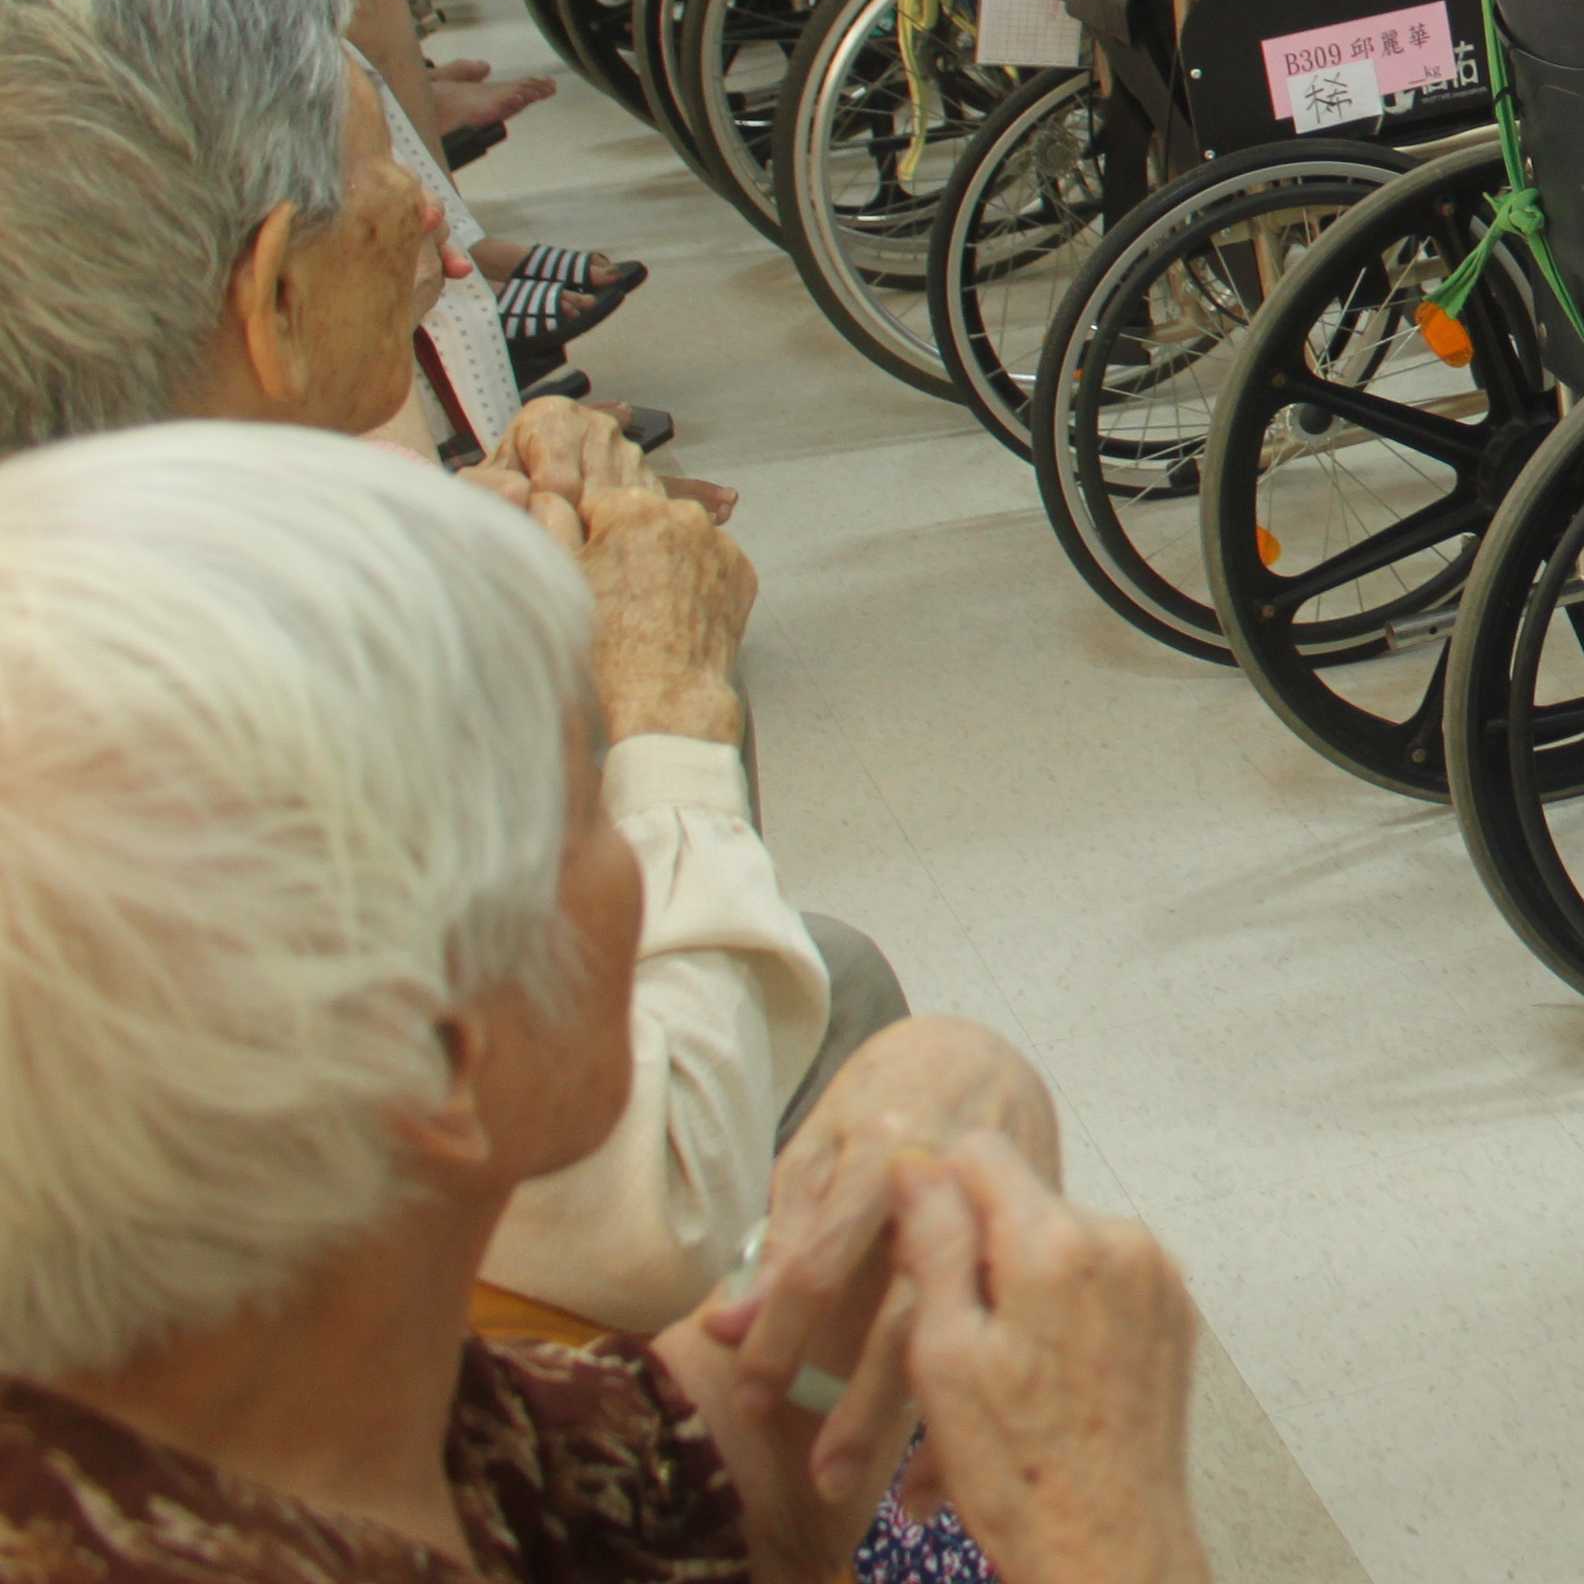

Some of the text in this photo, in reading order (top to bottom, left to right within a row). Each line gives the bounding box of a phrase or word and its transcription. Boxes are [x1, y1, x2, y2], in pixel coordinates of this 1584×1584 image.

[1284, 22, 1431, 76] B309 邱麗華
